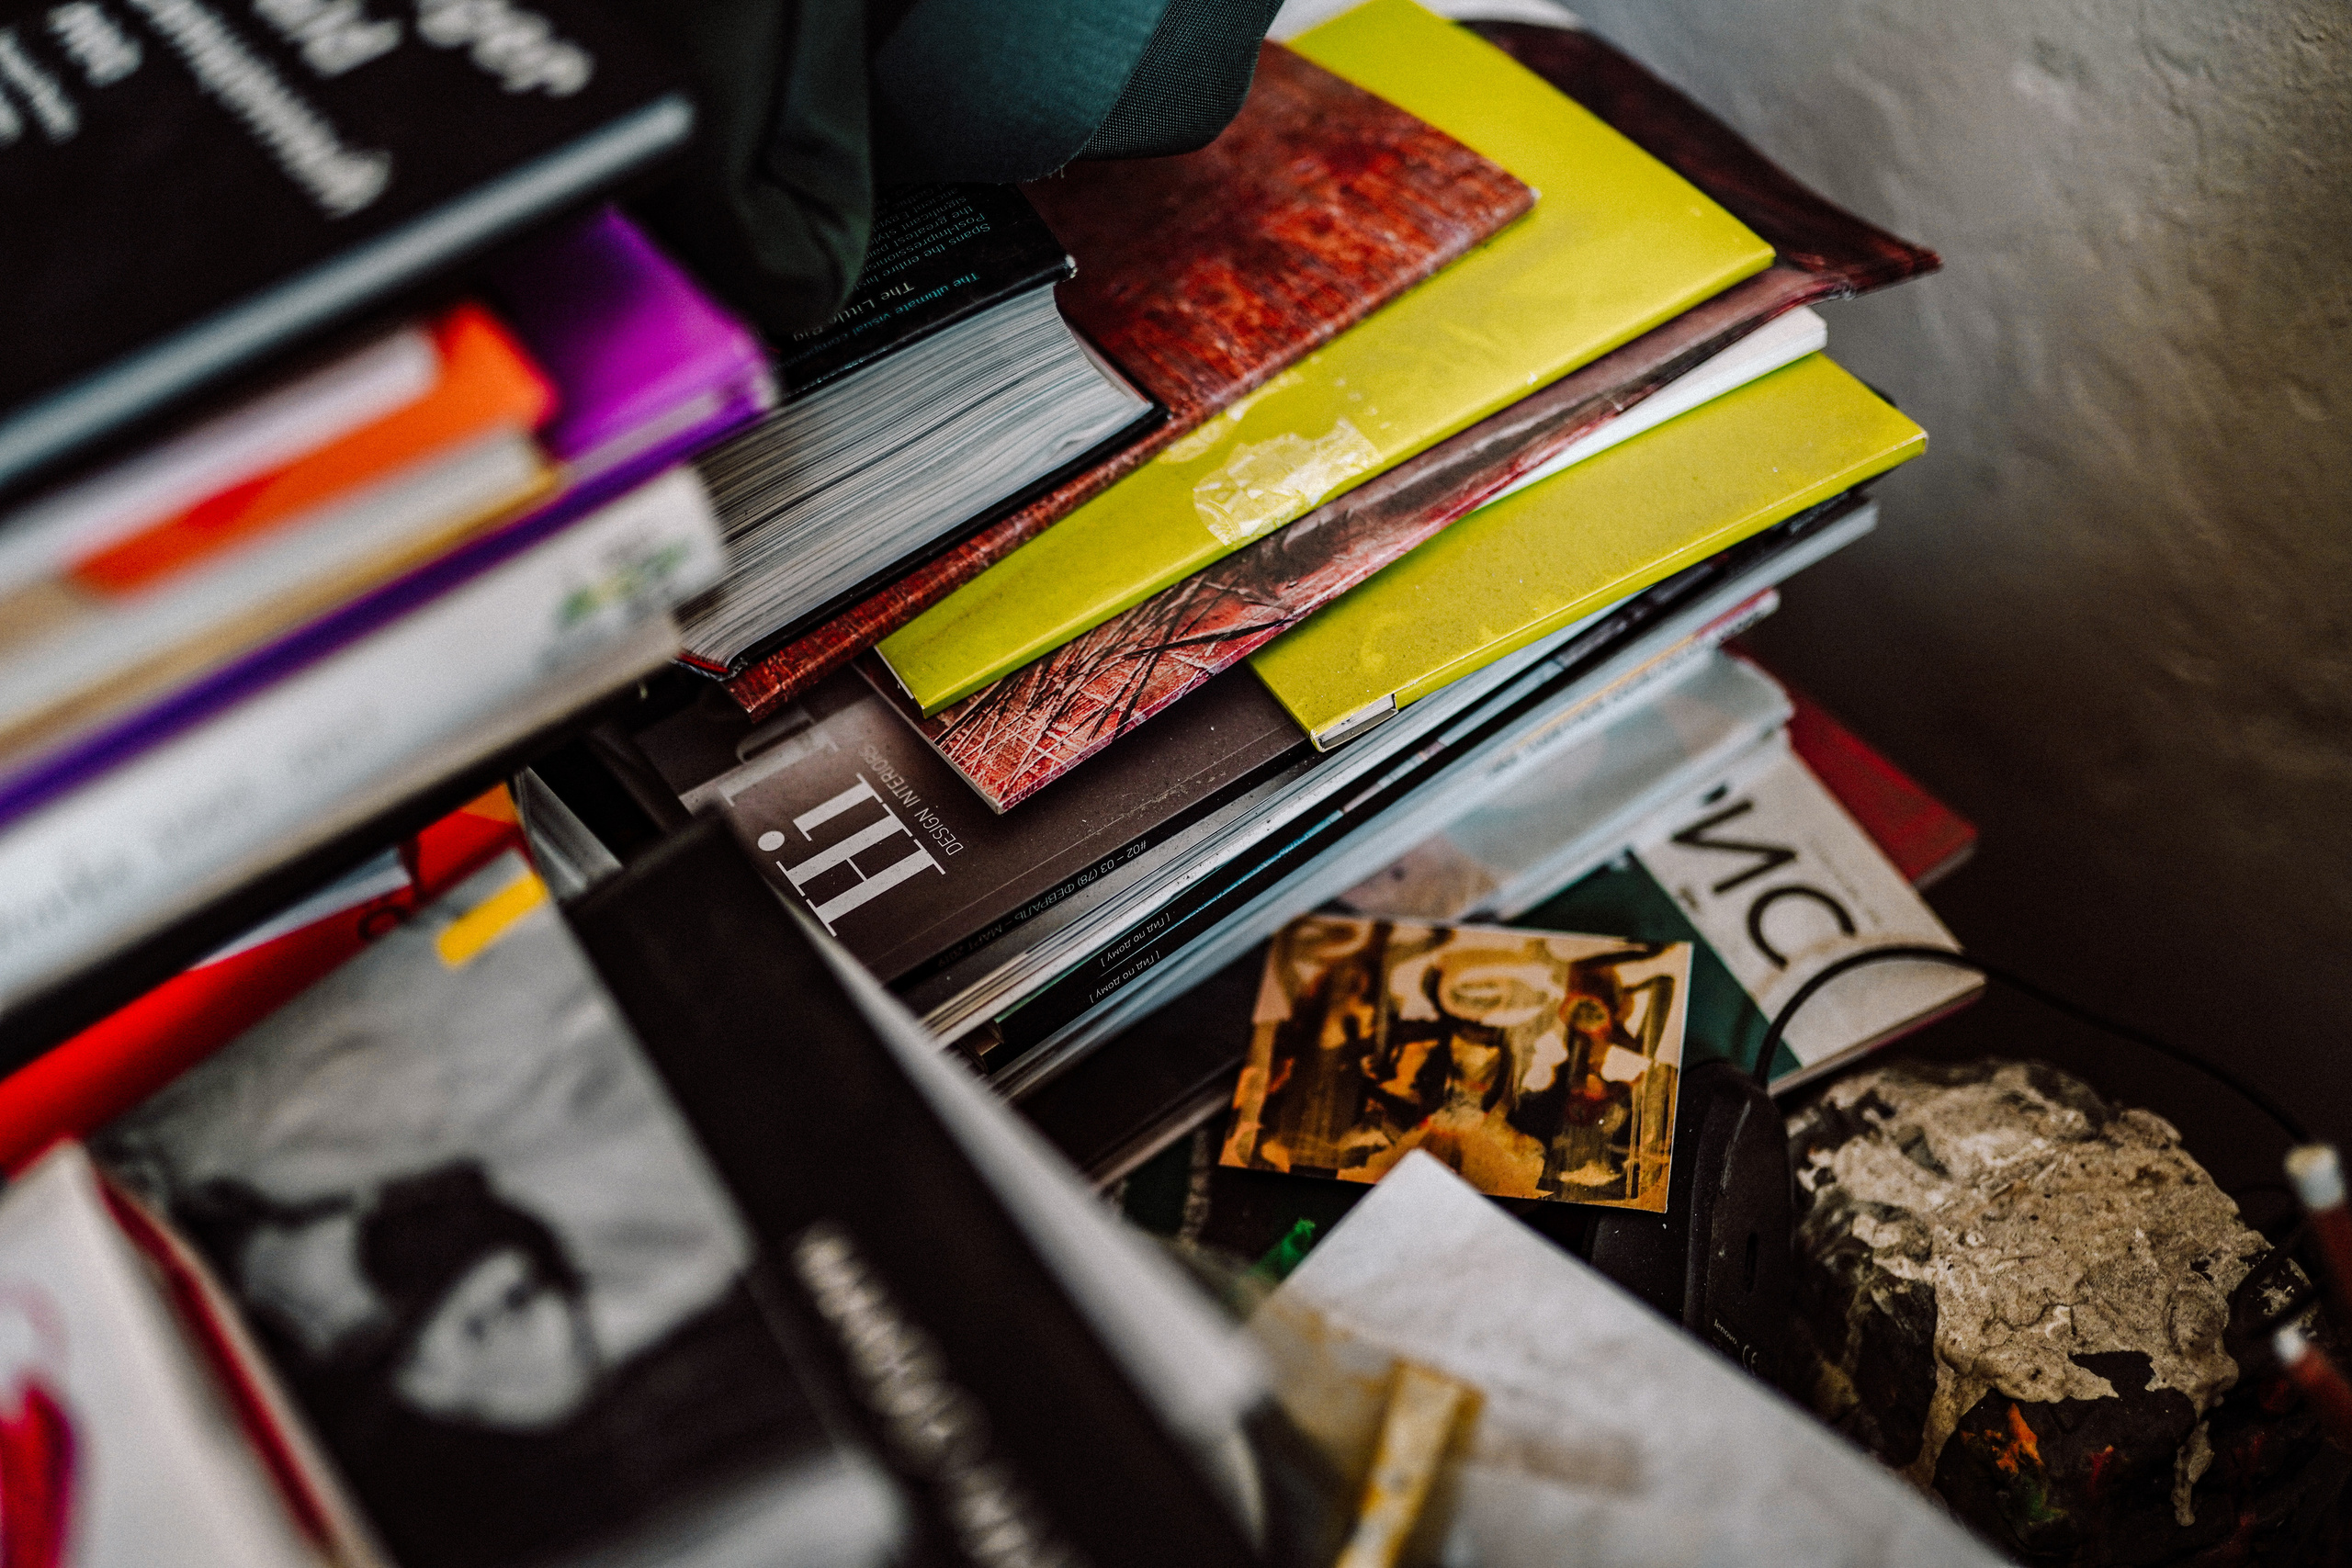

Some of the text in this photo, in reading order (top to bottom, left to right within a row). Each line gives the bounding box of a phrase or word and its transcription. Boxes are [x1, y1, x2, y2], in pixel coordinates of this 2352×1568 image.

[899, 193, 967, 231] significant
[911, 186, 959, 214] ancient
[951, 204, 972, 220] the
[892, 214, 947, 247] greatest
[947, 221, 989, 247] Spans
[922, 243, 944, 258] the
[881, 254, 920, 277] entire
[878, 279, 914, 303] The
[952, 270, 979, 289] The
[894, 284, 949, 316] ultimate
[852, 311, 891, 335] visual
[857, 740, 964, 856] DESIGN INTERIORS
[758, 772, 945, 937] Hi
[1125, 838, 1147, 858] #02
[1075, 865, 1098, 888] (78)
[1099, 857, 1115, 874] 03
[1012, 880, 1076, 923] ФЕВРАЛЬ
[967, 921, 1003, 951] МАРТ
[1131, 930, 1147, 944] по
[1145, 916, 1165, 935] Гид
[1103, 937, 1133, 963] дому
[1121, 966, 1136, 981] по
[1135, 953, 1155, 972] Гид
[1093, 974, 1122, 999] дому
[1713, 1318, 1737, 1345] lenovo
